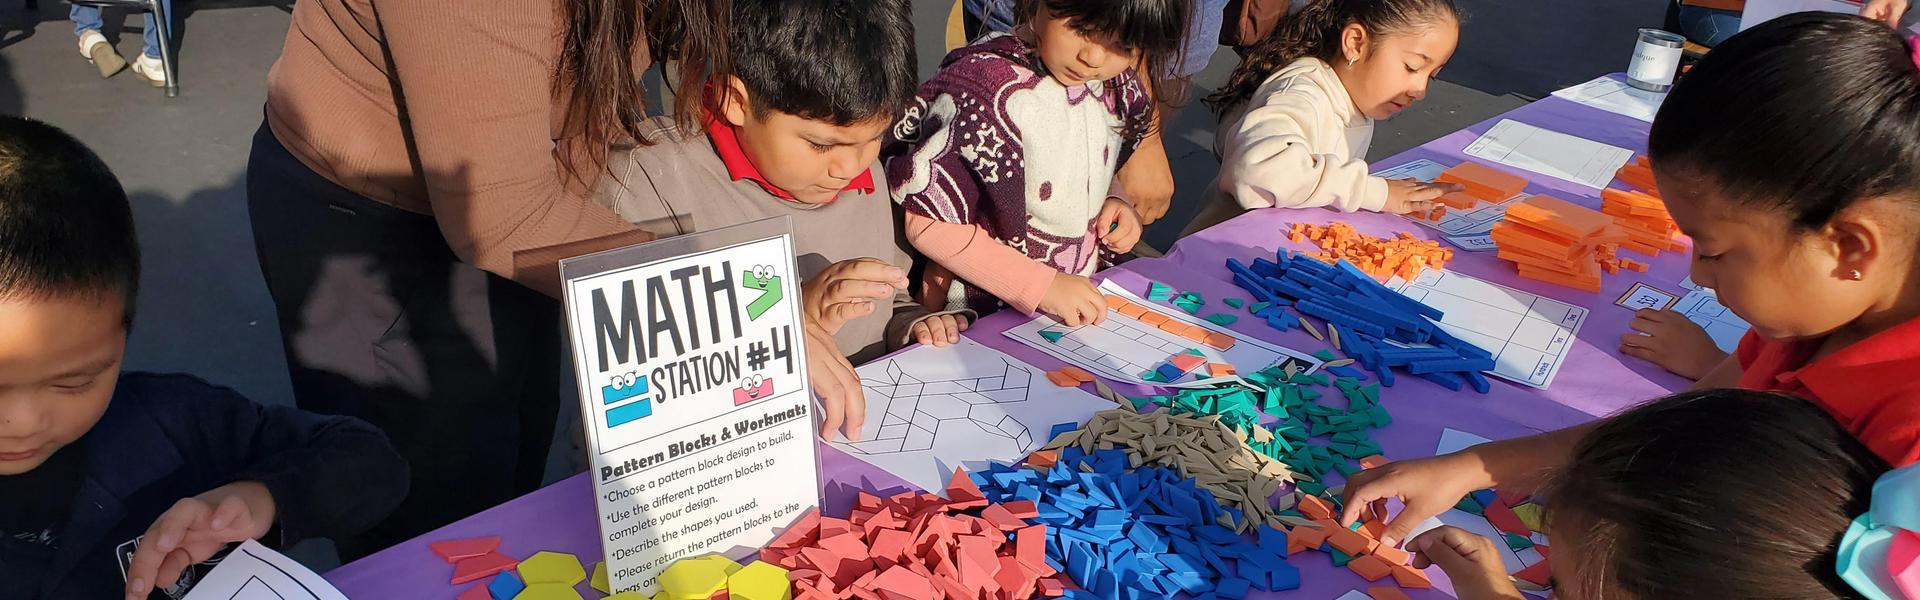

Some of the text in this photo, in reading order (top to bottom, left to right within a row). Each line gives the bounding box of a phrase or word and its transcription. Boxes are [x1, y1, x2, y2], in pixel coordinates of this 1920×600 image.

[591, 260, 743, 373] MATH
[1637, 295, 1659, 308] 532
[651, 325, 793, 404] STATION #4
[601, 404, 807, 481] Pattern Blocks & Workmats
[648, 480, 656, 489] a
[658, 466, 695, 488] pattern
[697, 455, 724, 471] block
[726, 445, 755, 462] design
[757, 441, 767, 451] to
[769, 430, 794, 446] build.
[633, 503, 650, 516] the
[652, 486, 694, 509] different
[697, 473, 733, 494] pattern
[735, 462, 763, 478] blocks
[765, 458, 775, 468] to
[609, 496, 718, 542] complete your design.
[655, 549, 685, 567] return
[687, 541, 704, 553] the
[706, 527, 742, 548] pattern
[744, 514, 772, 531] blocks
[773, 510, 783, 519] to
[785, 503, 799, 514] the
[661, 531, 678, 543] the
[681, 518, 713, 536] shapes
[715, 510, 733, 525] you
[735, 498, 758, 514] used.
[643, 577, 656, 588] on
